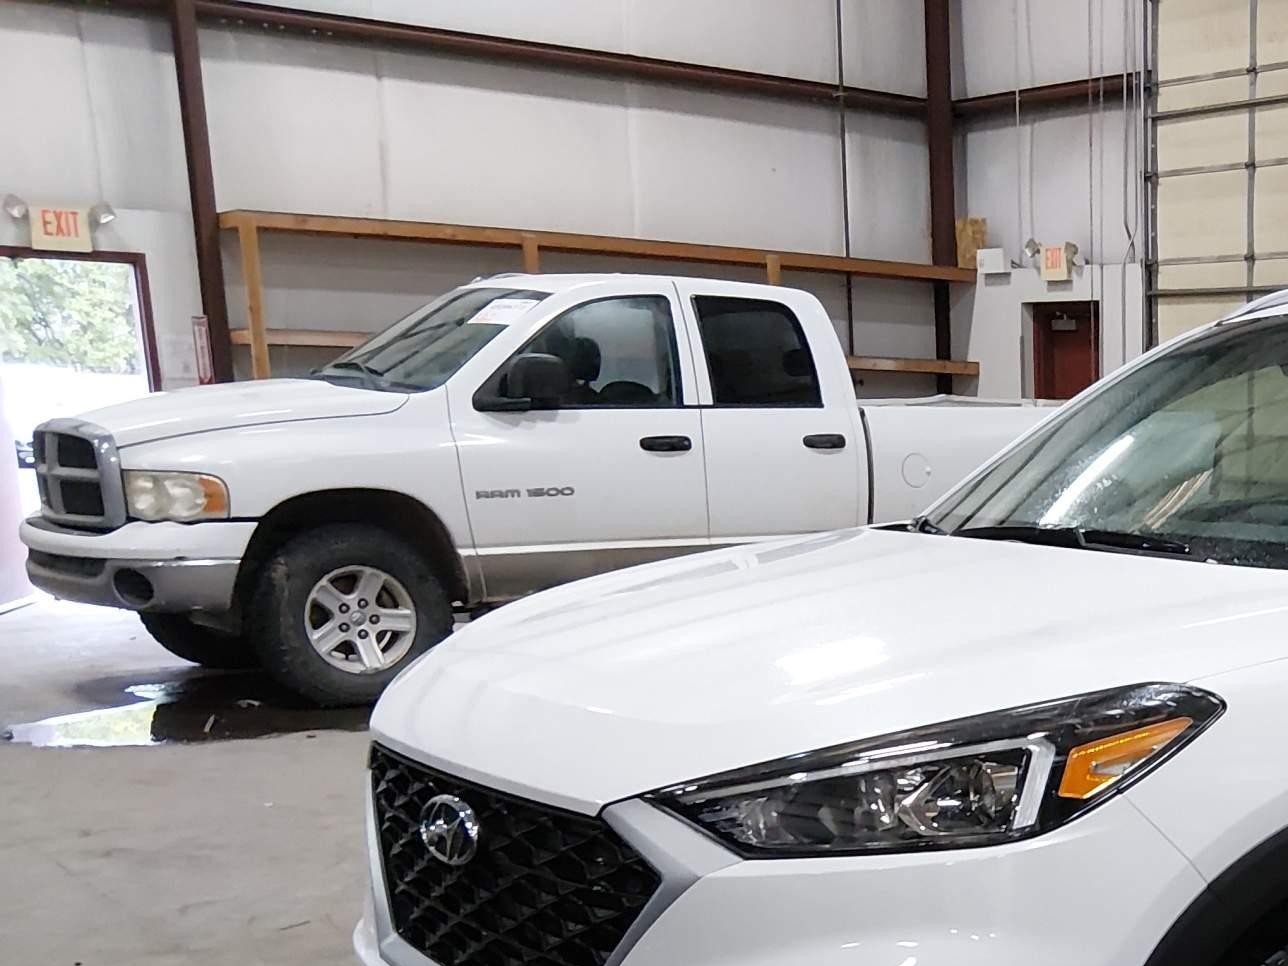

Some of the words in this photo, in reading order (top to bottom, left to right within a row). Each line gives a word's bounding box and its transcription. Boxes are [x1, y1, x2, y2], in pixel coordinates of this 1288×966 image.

[41, 209, 79, 237] EXIT
[475, 489, 521, 500] RAM
[526, 486, 575, 498] 1500
